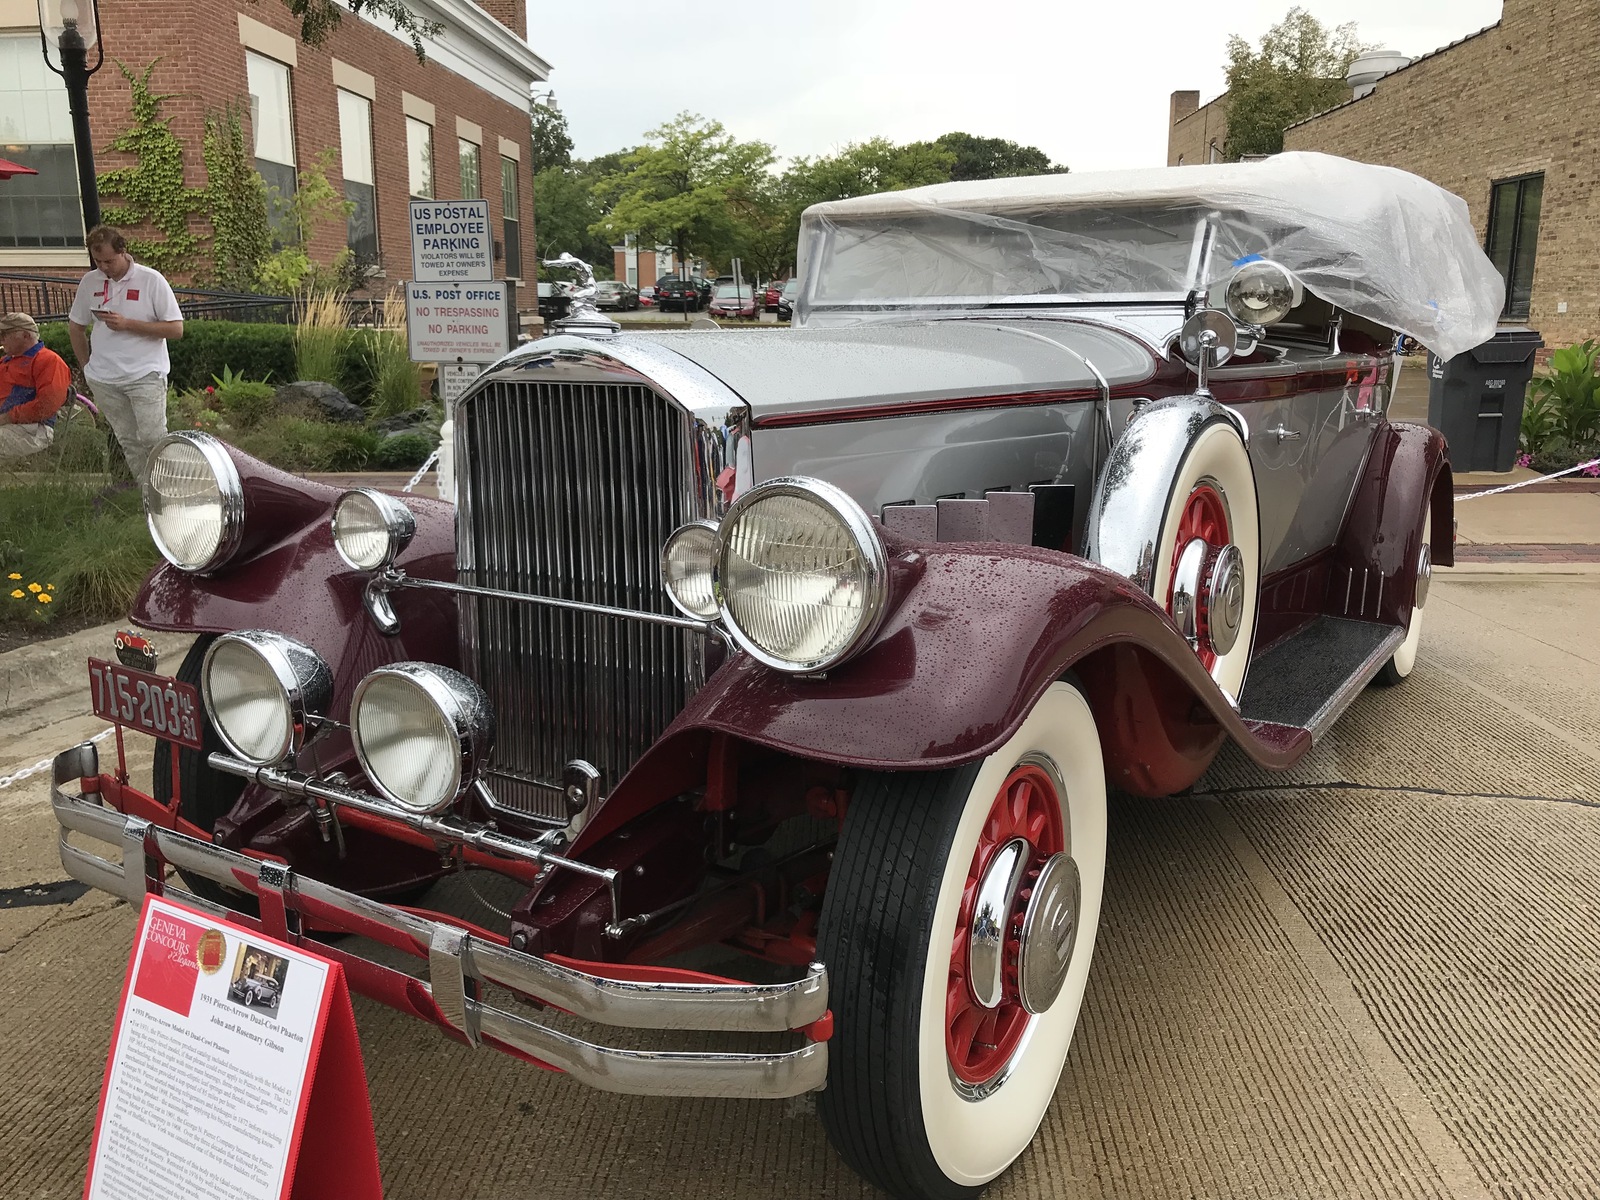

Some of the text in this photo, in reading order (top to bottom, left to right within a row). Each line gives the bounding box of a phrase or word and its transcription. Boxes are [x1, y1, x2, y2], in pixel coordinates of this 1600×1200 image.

[414, 207, 484, 219] US POSTAL
[416, 223, 484, 234] EMPLOYEE
[424, 238, 480, 250] PARKING
[413, 290, 500, 300] U.S. POST OFFICE
[416, 307, 499, 317] NO TRESPASSING
[429, 325, 488, 334] NO PARKING
[92, 668, 180, 736] 715-203
[182, 716, 197, 740] 31
[149, 916, 188, 940] GENEVA
[146, 930, 190, 955] CONCOURS
[167, 951, 200, 972] d'Eleganc
[200, 994, 304, 1042] 1931 Pierce-Arrow Dual-Cowl Phaeton
[135, 1008, 144, 1016] 1931
[145, 1013, 171, 1027] Pierce-Arrow
[172, 1024, 184, 1034] Model
[190, 1033, 212, 1046] Dual-Cowl
[213, 1043, 230, 1054] Phaeton
[210, 1015, 285, 1053] John and Rosemary Gibson
